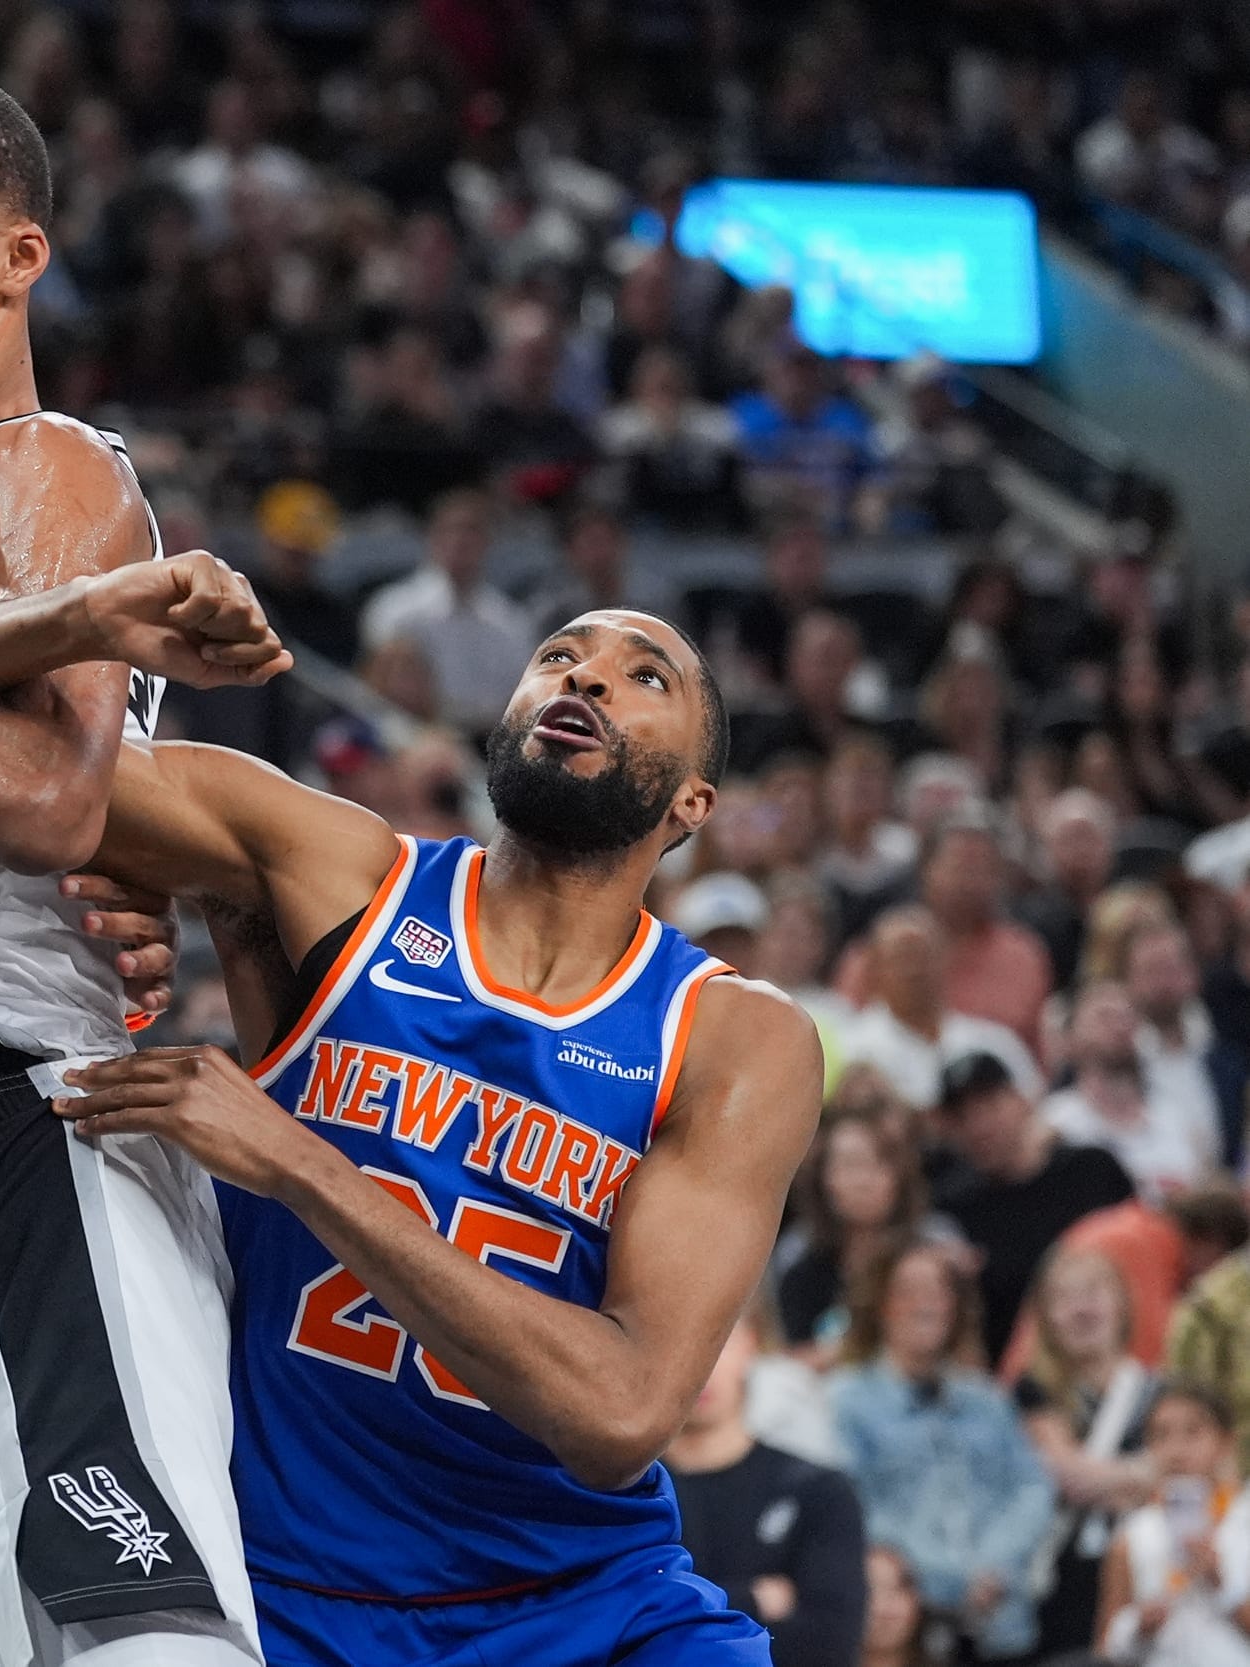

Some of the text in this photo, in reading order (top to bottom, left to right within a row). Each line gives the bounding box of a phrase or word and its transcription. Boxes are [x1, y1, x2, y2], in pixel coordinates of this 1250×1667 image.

[396, 934, 440, 965] 250
[407, 921, 444, 951] USA
[557, 1049, 655, 1081] abu dhabi
[562, 1039, 613, 1060] experience
[295, 1036, 643, 1232] NEW YORK
